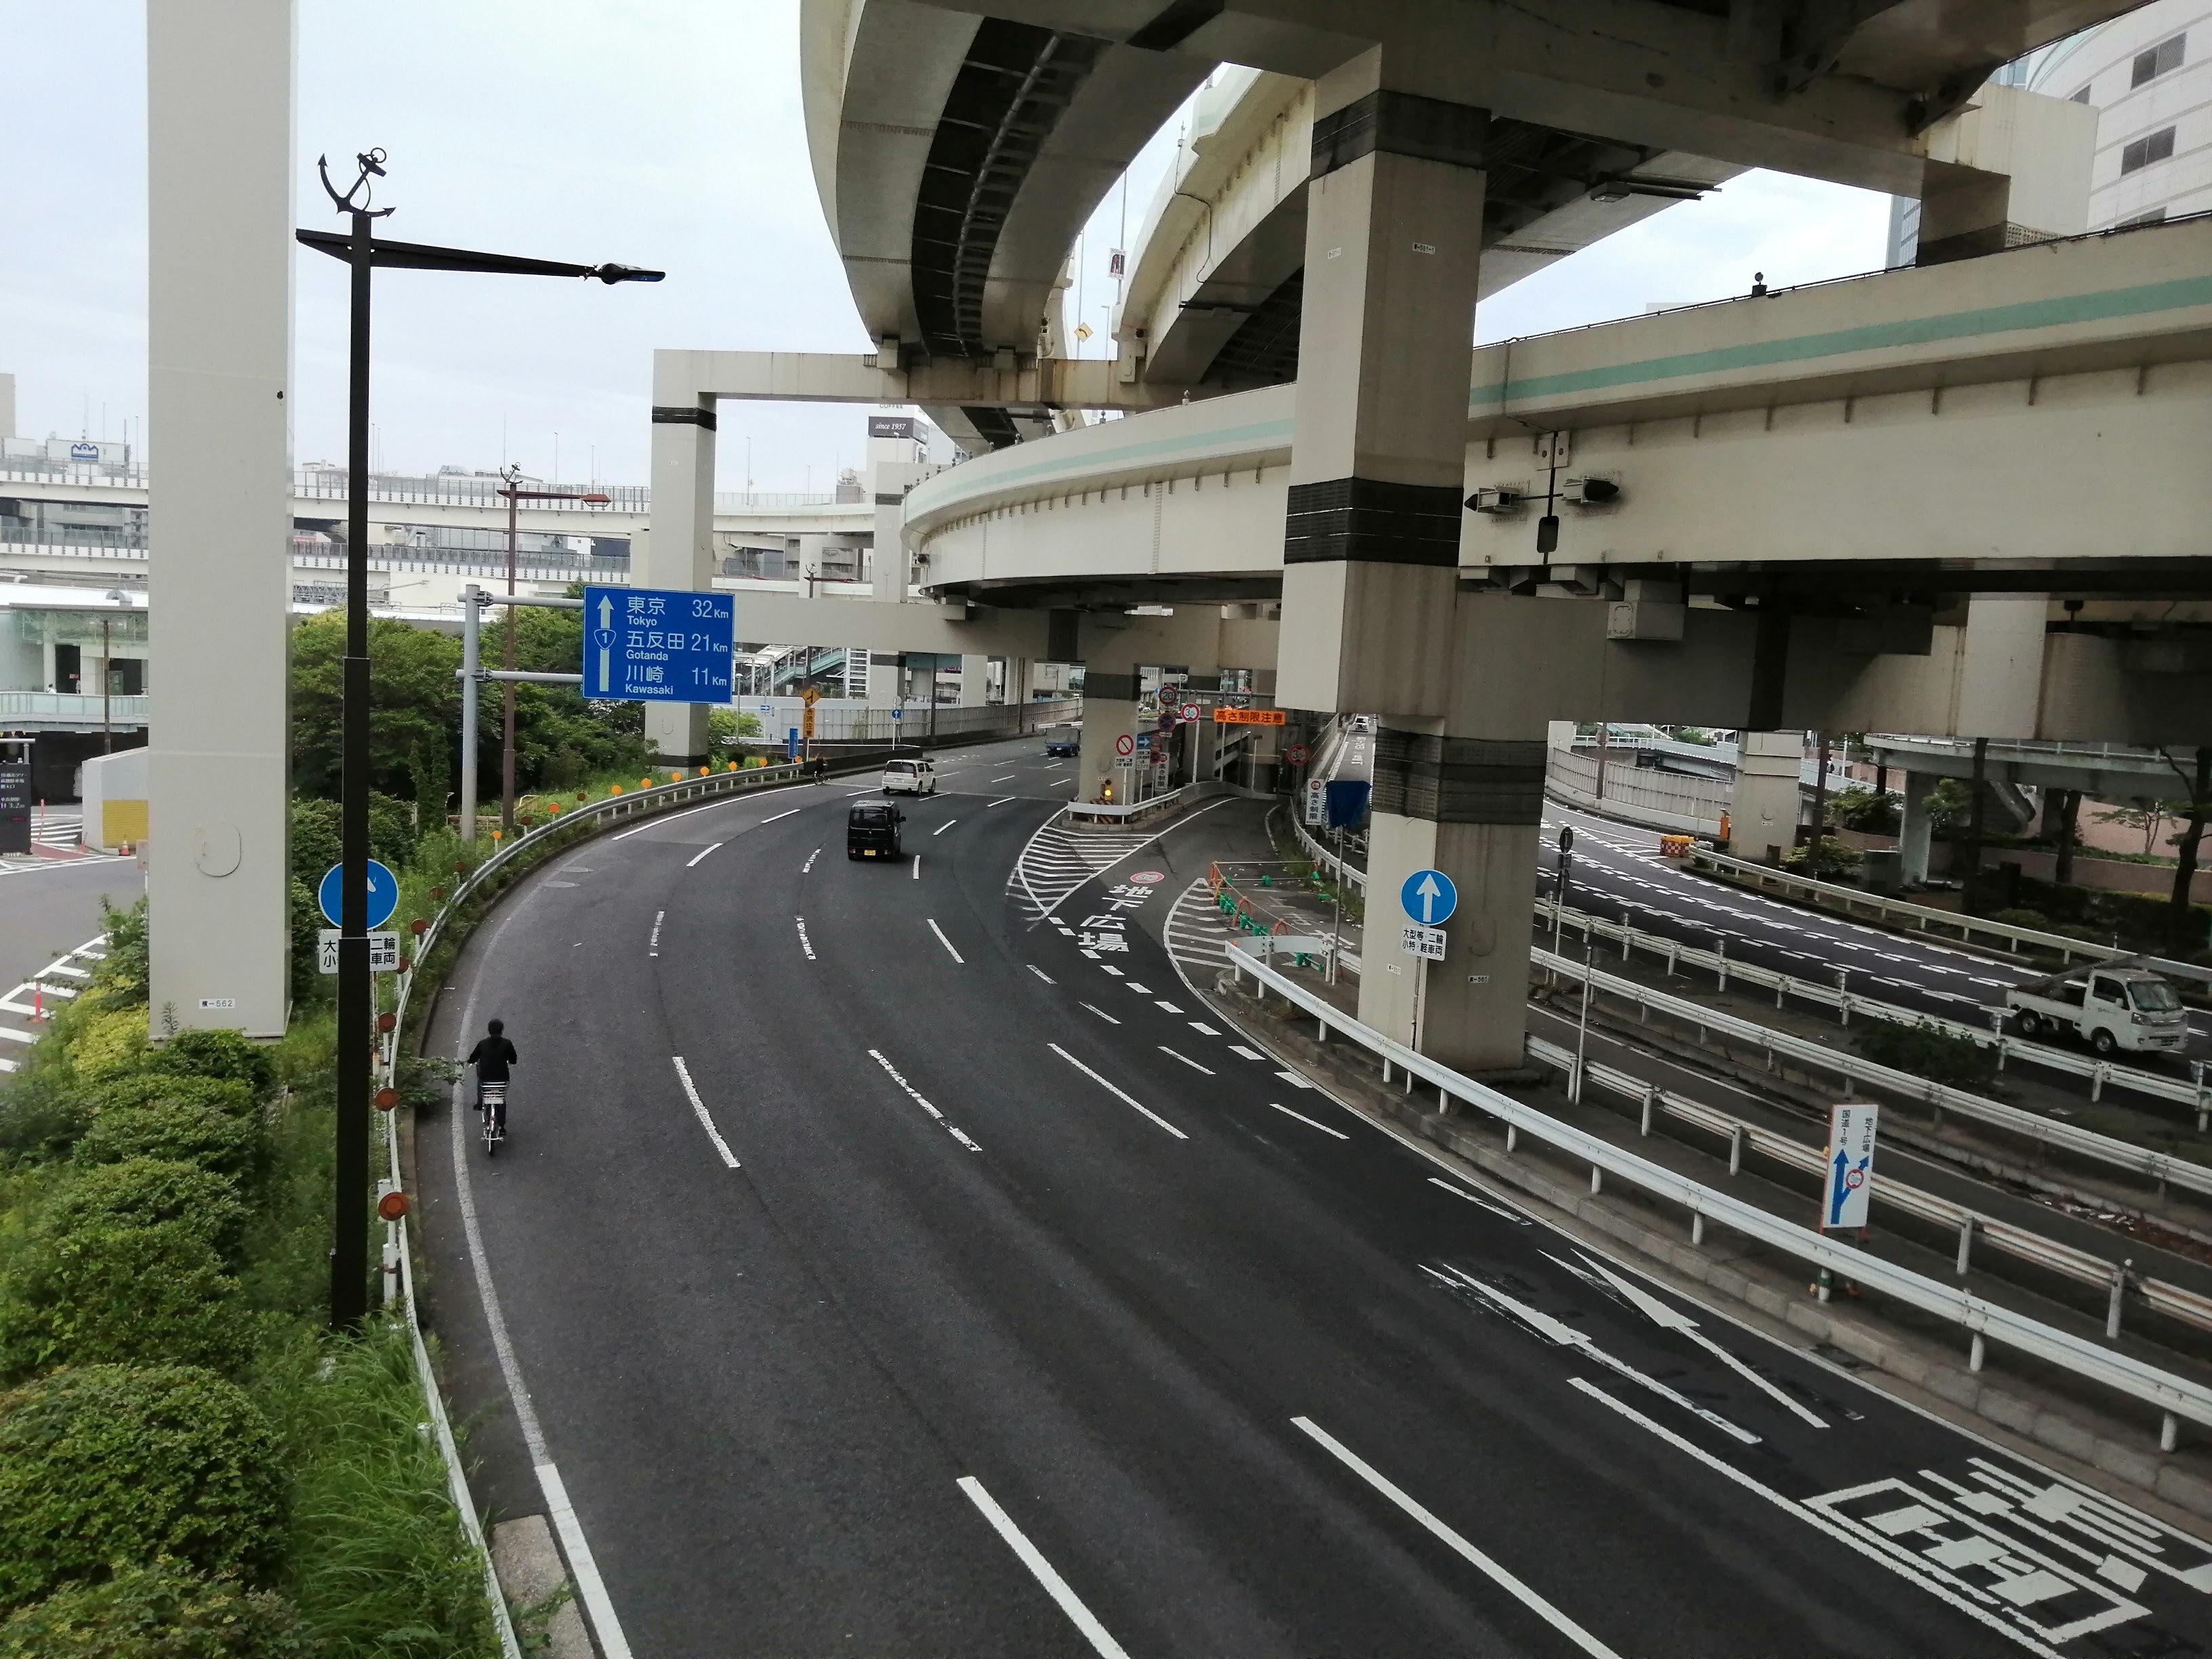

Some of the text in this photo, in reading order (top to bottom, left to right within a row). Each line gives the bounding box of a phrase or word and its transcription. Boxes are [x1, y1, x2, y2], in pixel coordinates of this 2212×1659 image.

[626, 596, 665, 615] 東京
[627, 615, 657, 628] Tokyo
[602, 632, 608, 644] 1
[626, 630, 684, 650] 五反田
[626, 649, 669, 661] Gotanda
[626, 664, 664, 683] 川崎
[625, 683, 674, 695] Kawasaki
[1162, 691, 1174, 700] 20
[1216, 710, 1284, 723] 高さ制限注意
[1309, 792, 1320, 820] 高さ制限
